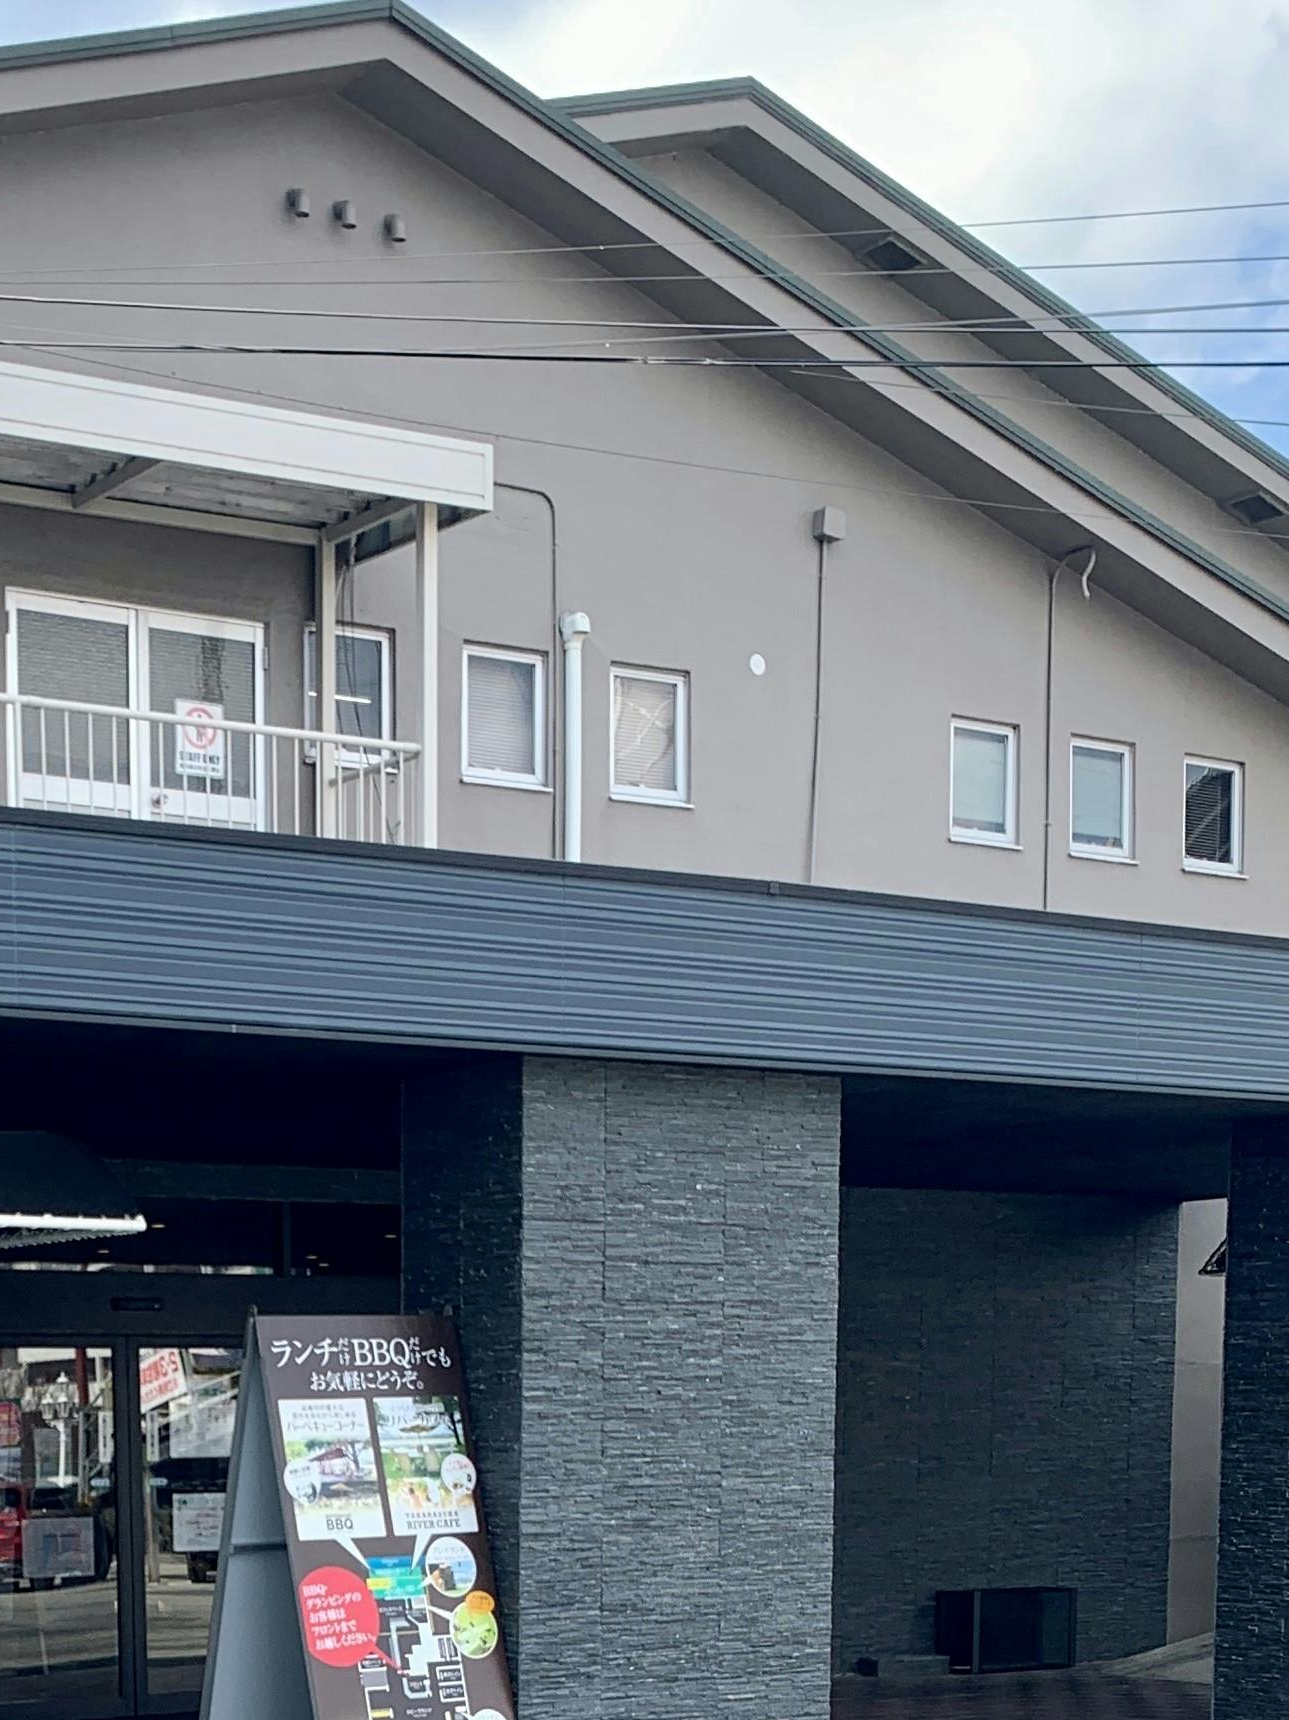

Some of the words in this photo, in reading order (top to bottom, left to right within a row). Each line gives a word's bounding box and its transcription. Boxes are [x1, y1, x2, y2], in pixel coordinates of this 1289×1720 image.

[310, 1370, 425, 1392] お気軽にどうぞ。
[326, 1518, 354, 1531] BBQ
[406, 1520, 435, 1530] RIVER
